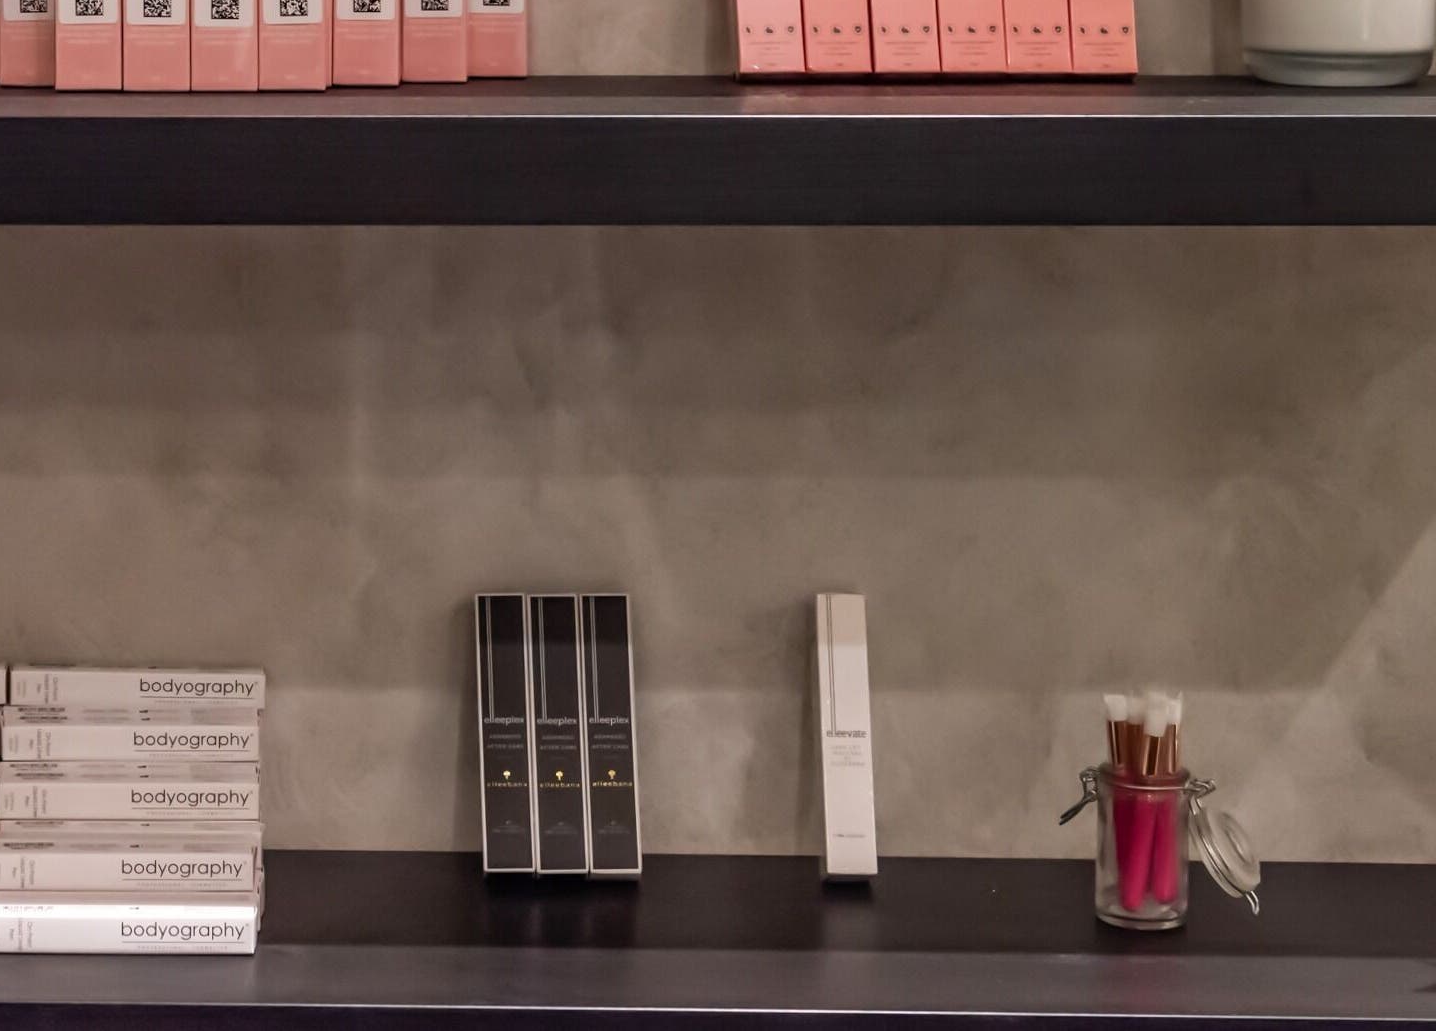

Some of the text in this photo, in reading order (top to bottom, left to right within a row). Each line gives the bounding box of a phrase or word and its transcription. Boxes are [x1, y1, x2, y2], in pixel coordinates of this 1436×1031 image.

[139, 678, 254, 696] bodyography
[133, 732, 250, 749] bodyography
[131, 789, 250, 806] bodyography
[121, 860, 243, 878] bodyography
[121, 922, 244, 939] bodyography
